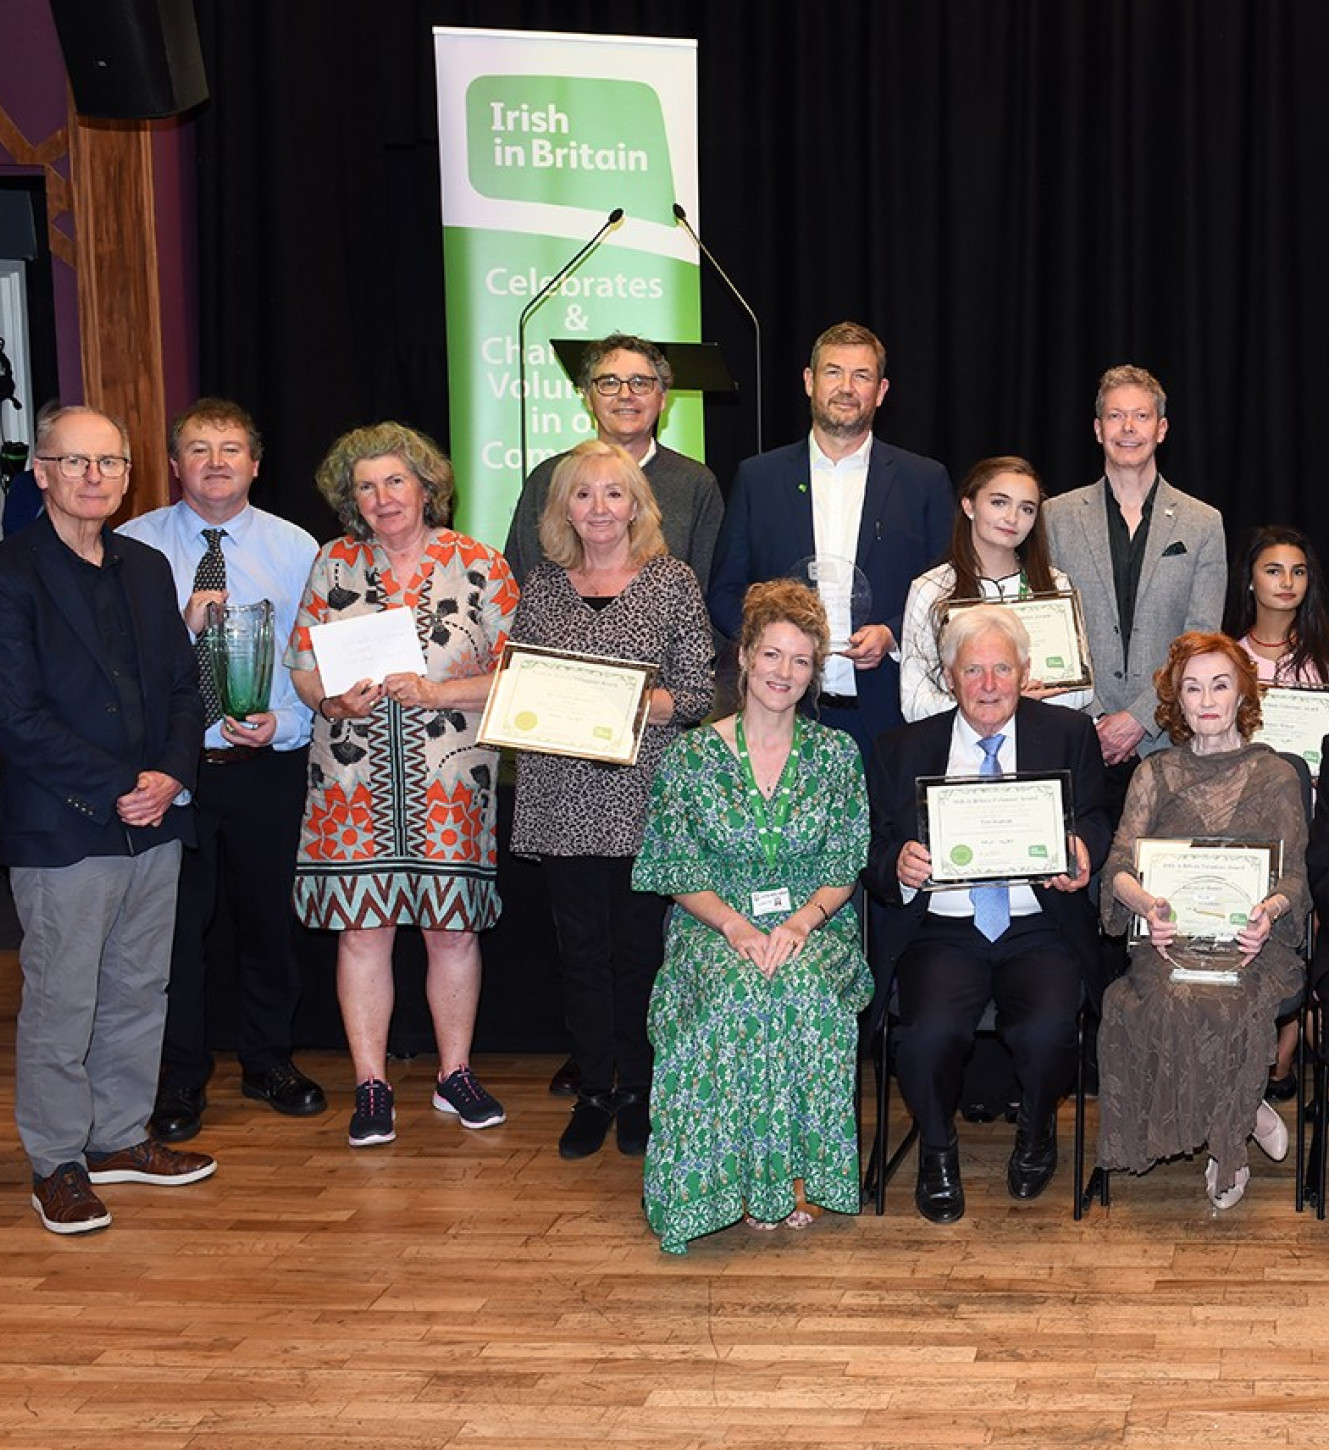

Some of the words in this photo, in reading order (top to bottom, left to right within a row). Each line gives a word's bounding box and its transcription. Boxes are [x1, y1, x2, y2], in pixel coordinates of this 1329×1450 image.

[489, 102, 569, 134] Irish
[494, 137, 525, 167] in
[531, 138, 648, 172] Britain
[486, 266, 663, 298] Celebrates
[564, 304, 589, 331] &
[531, 405, 562, 434] in
